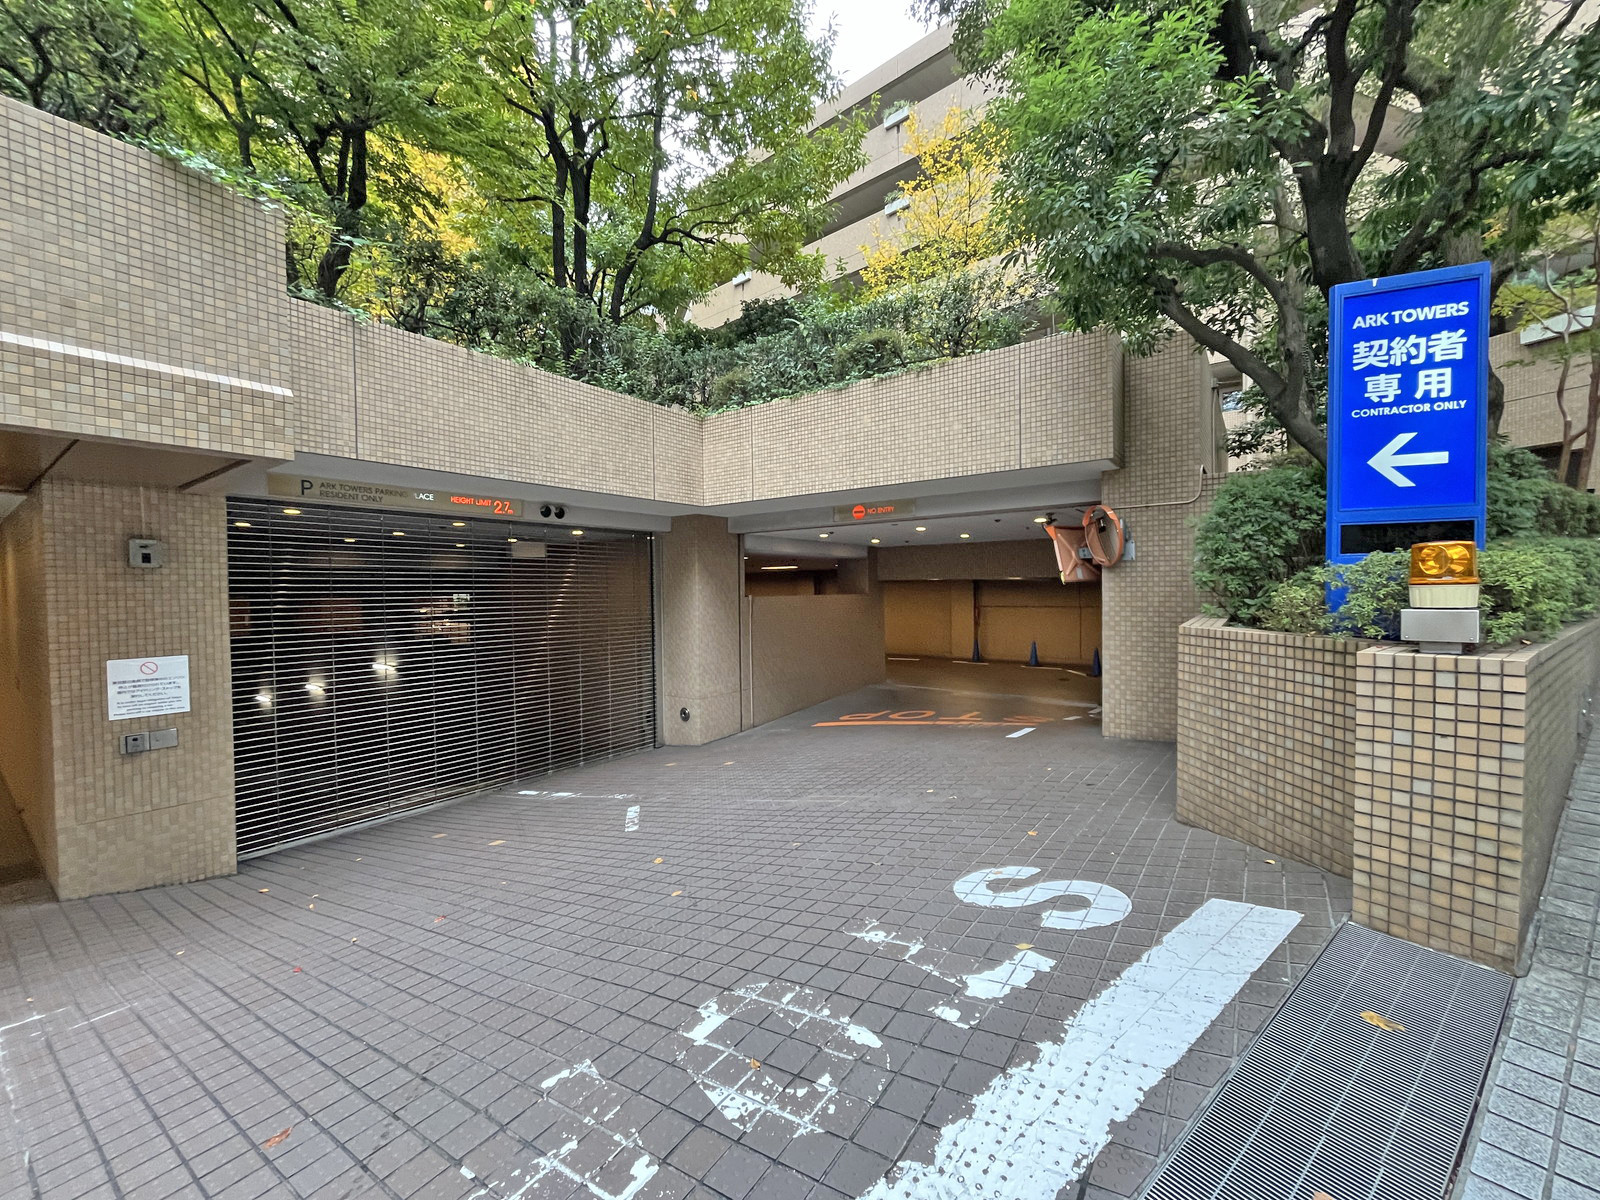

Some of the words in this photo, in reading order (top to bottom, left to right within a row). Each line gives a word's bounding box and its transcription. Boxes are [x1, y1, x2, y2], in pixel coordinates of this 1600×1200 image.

[1352, 312, 1390, 330] ARK
[1391, 301, 1470, 325] TOWERS
[1351, 328, 1468, 371] 契約者
[1364, 367, 1452, 403] 専用
[1351, 403, 1431, 419] CONTRACTOR
[1433, 399, 1467, 411] ONLY
[301, 480, 313, 495] P
[320, 482, 337, 490] ARK
[339, 484, 373, 494] TOWERS
[320, 490, 359, 500] RESIDENT
[362, 495, 384, 503] ONLY
[450, 496, 474, 505] HEIGHT
[877, 506, 895, 514] ENTRY
